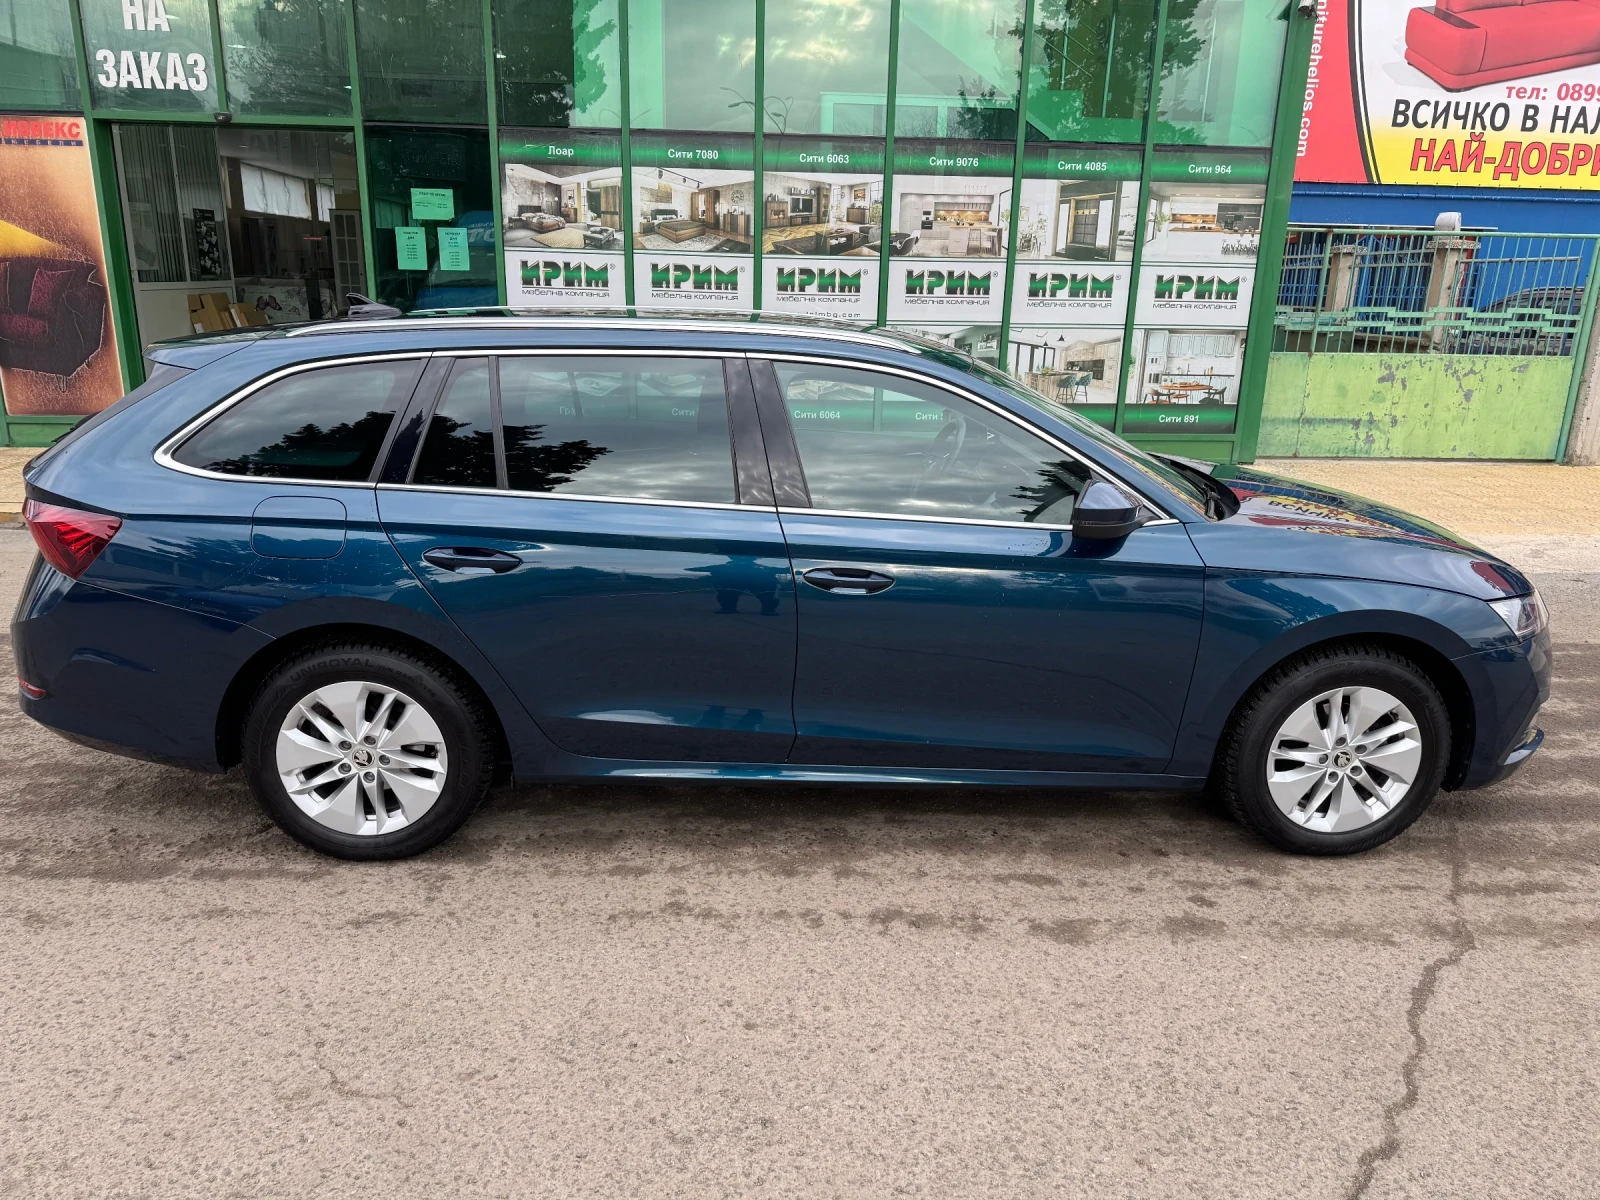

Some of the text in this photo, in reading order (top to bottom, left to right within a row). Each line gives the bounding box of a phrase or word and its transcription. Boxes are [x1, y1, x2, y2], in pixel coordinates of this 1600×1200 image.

[122, 0, 170, 31] НА
[96, 49, 208, 91] ЗАКАЗ
[1506, 85, 1548, 100] тел:
[1391, 98, 1510, 132] ВСИЧКО
[1521, 104, 1540, 132] В
[548, 145, 574, 157] Лоар
[668, 149, 719, 159] Сити 7080
[799, 153, 850, 163] Сити 6063
[929, 157, 979, 167] Сити 9076
[1058, 161, 1107, 171] Сити 4085
[1188, 165, 1232, 174] Сити 964
[520, 259, 609, 288] ИРИМ
[650, 263, 738, 291] ИРИМ
[776, 267, 861, 293] ИРИМ
[905, 269, 992, 295] ИРИМ
[1027, 272, 1115, 298] ИРИМ
[1154, 274, 1241, 300] ИРИМ
[671, 407, 695, 416] Сити
[794, 410, 841, 420] Сити 6064
[915, 412, 938, 421] Сити
[1158, 414, 1200, 423] Сити 891
[290, 657, 374, 682] UNIROYAL
